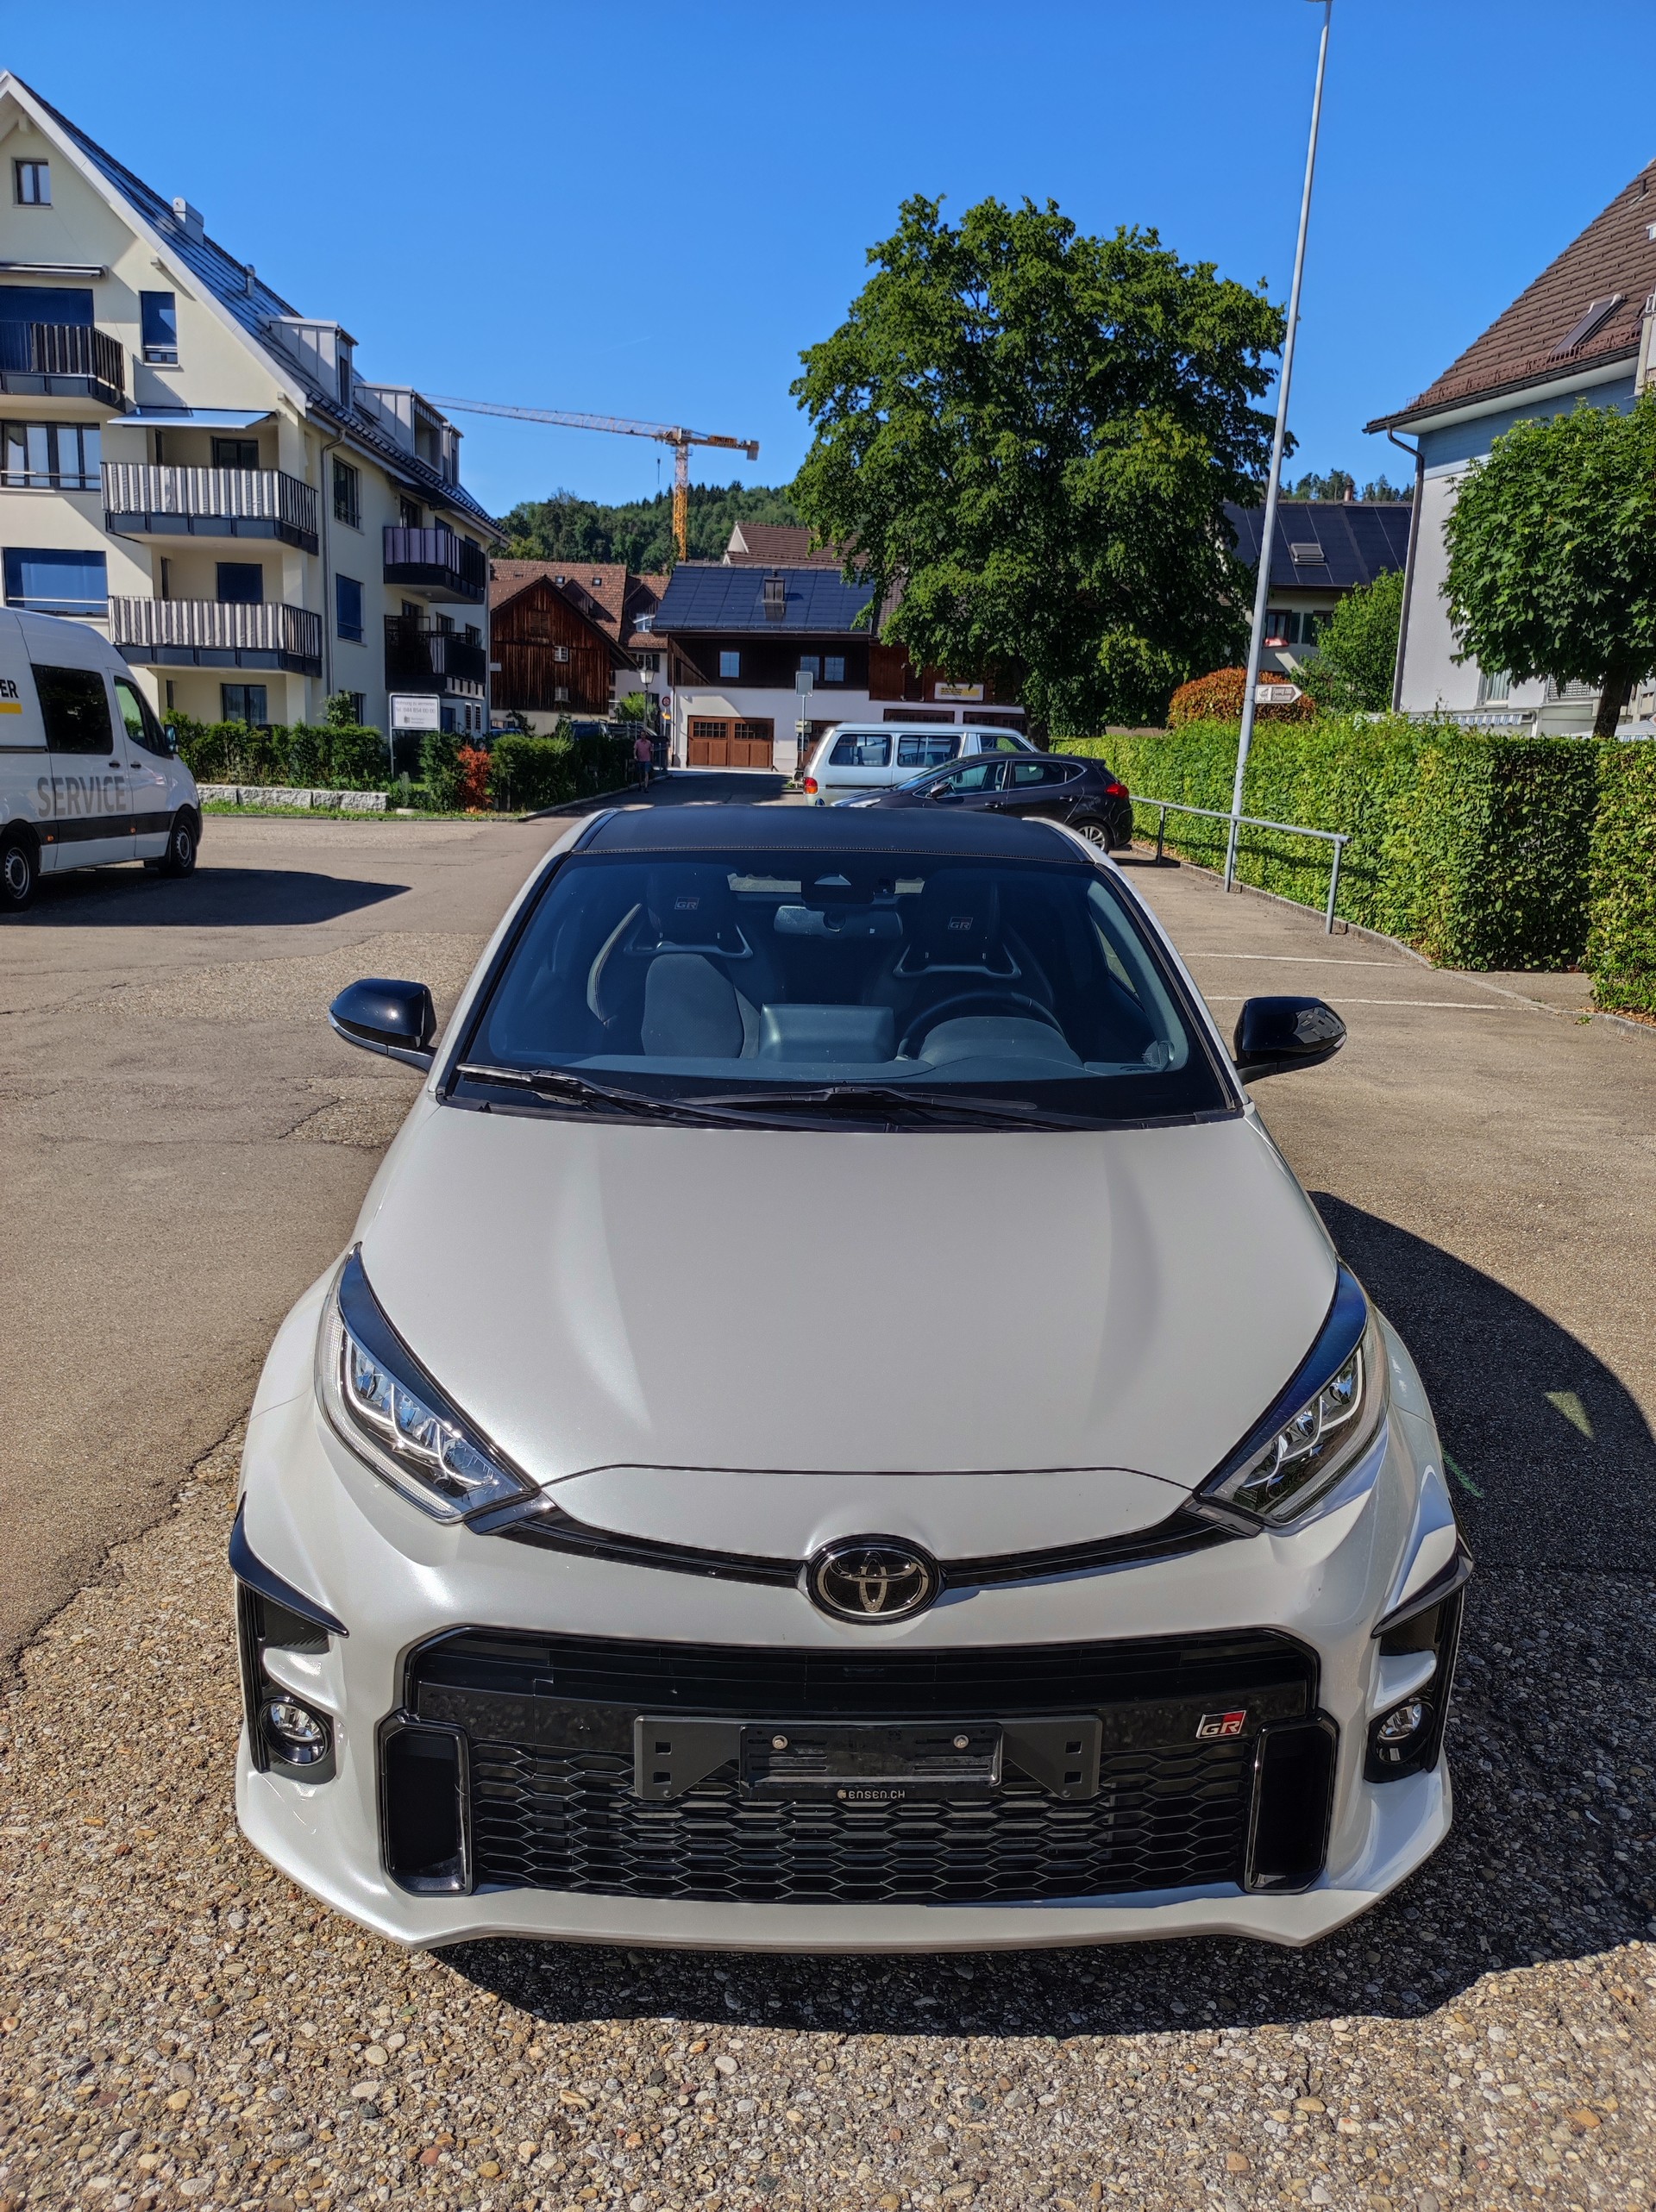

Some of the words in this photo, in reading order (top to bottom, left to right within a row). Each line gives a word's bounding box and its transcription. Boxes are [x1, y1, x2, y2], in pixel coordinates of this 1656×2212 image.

[37, 775, 127, 818] SERVICE
[676, 900, 697, 909] GR
[1201, 1720, 1241, 1736] GR
